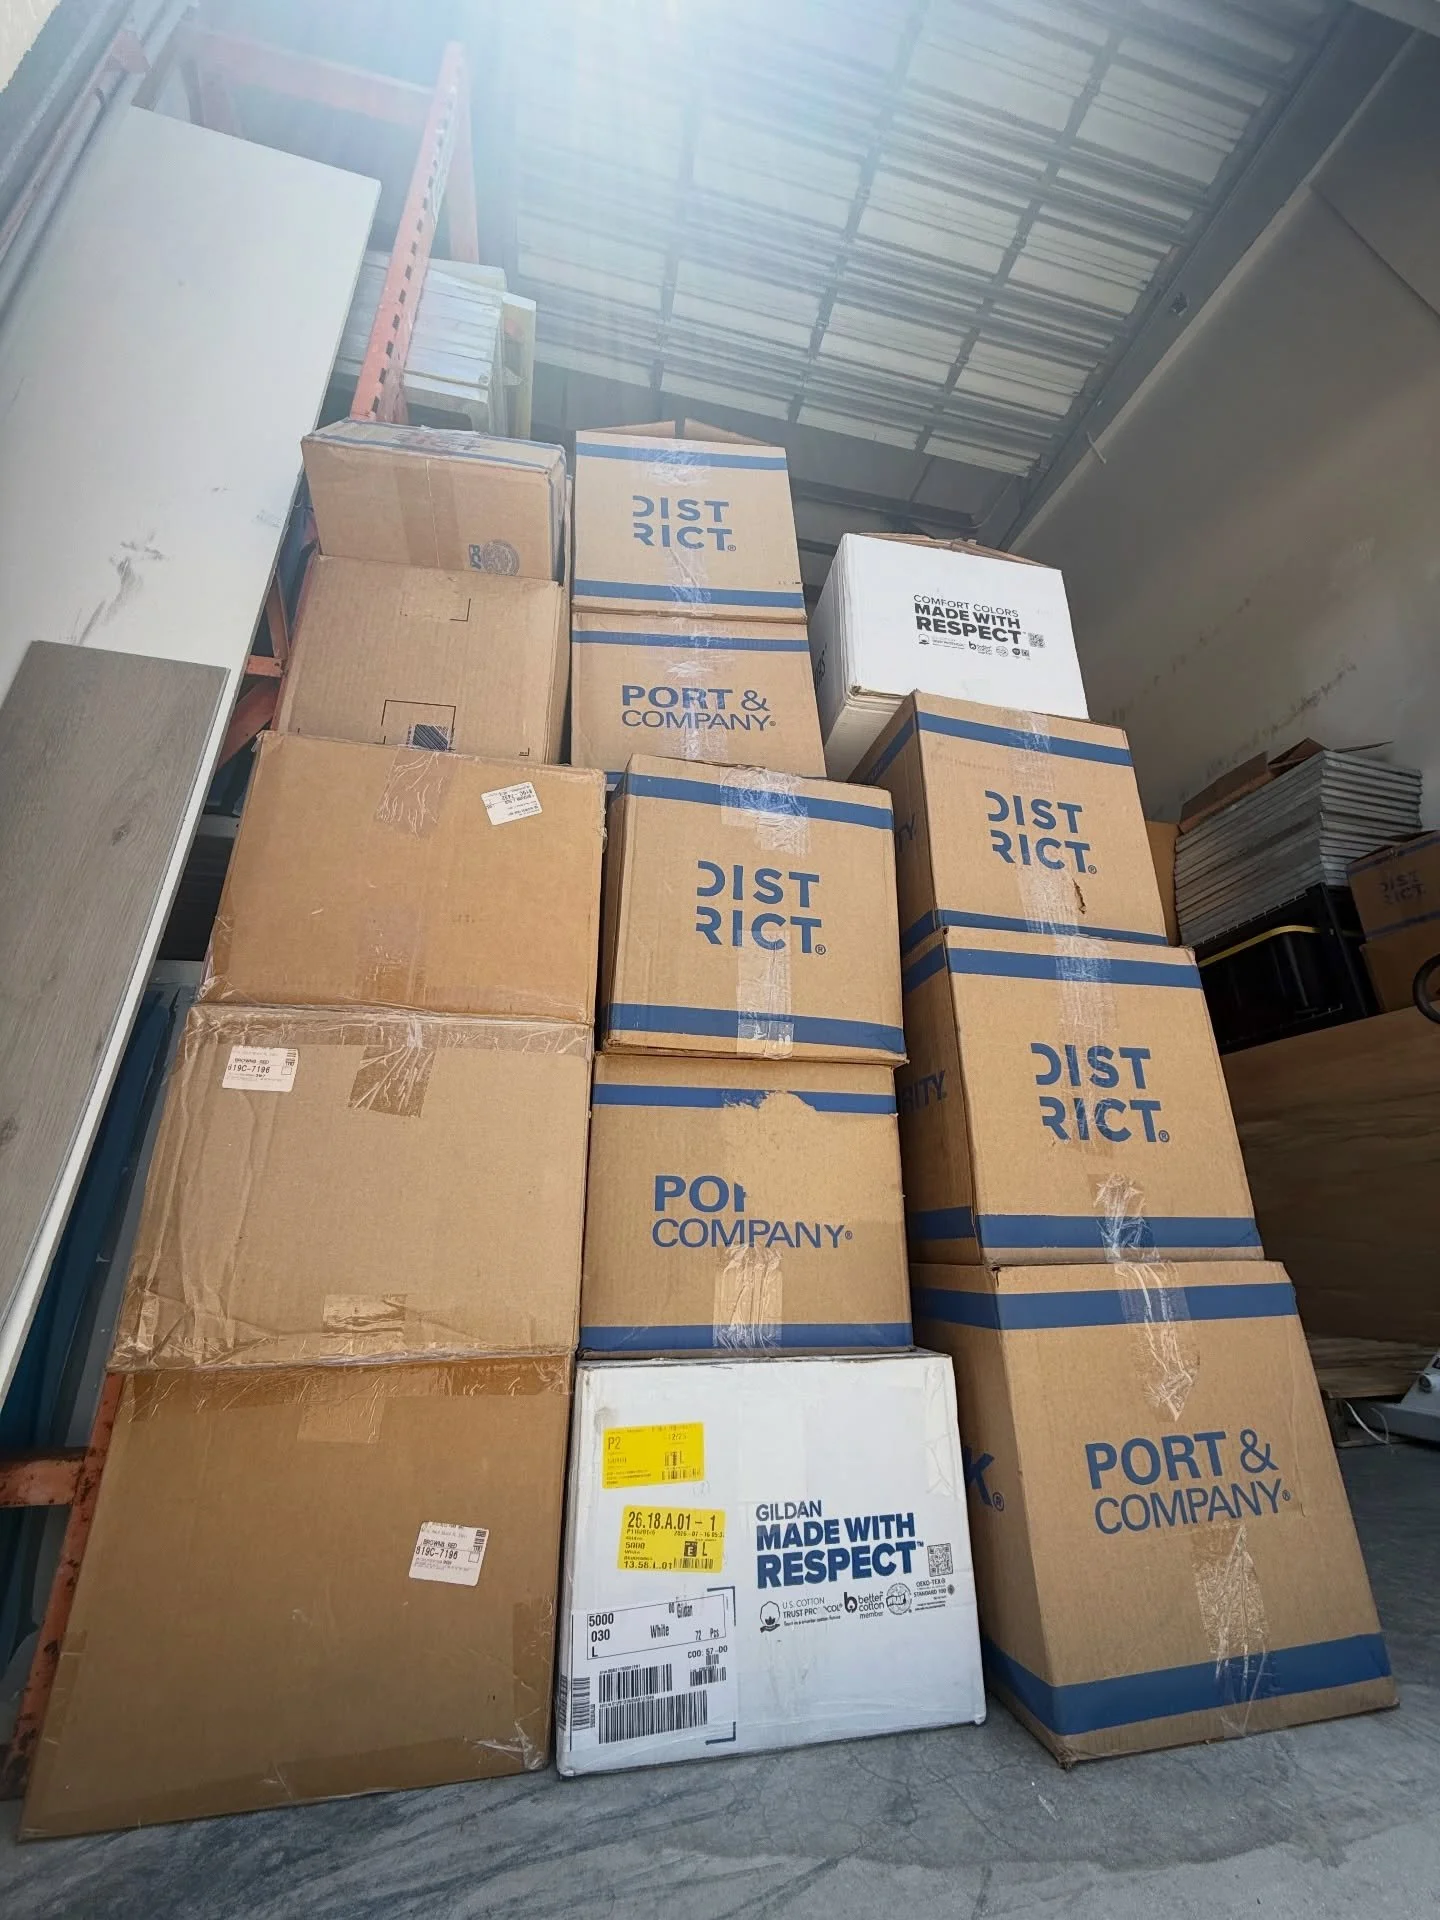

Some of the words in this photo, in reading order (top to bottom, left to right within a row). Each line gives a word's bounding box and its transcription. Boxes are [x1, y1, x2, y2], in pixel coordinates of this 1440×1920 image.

[632, 495, 729, 522] DIST
[914, 594, 969, 610] COMFORT
[973, 603, 1018, 617] COLORS
[914, 603, 969, 621] MADE
[973, 611, 1020, 629] WITH
[622, 685, 733, 709] PORT
[740, 689, 770, 711] &
[985, 790, 1083, 833] DIST
[697, 860, 820, 908] DIST
[1030, 1043, 1151, 1089] DIST
[607, 1436, 621, 1450] P2
[1085, 1431, 1226, 1489] PORT
[1240, 1428, 1279, 1474] &
[755, 1500, 822, 1521] GILDAN
[756, 1519, 840, 1551] MADE
[844, 1512, 915, 1543] WITH
[796, 1597, 825, 1607] COTTON
[858, 1601, 885, 1612] cotton
[588, 1612, 614, 1627] 5000
[783, 1609, 803, 1619] TRUST
[860, 1611, 883, 1619] member
[591, 1629, 610, 1642] 030
[650, 1624, 670, 1639] White
[591, 1646, 598, 1657] L
